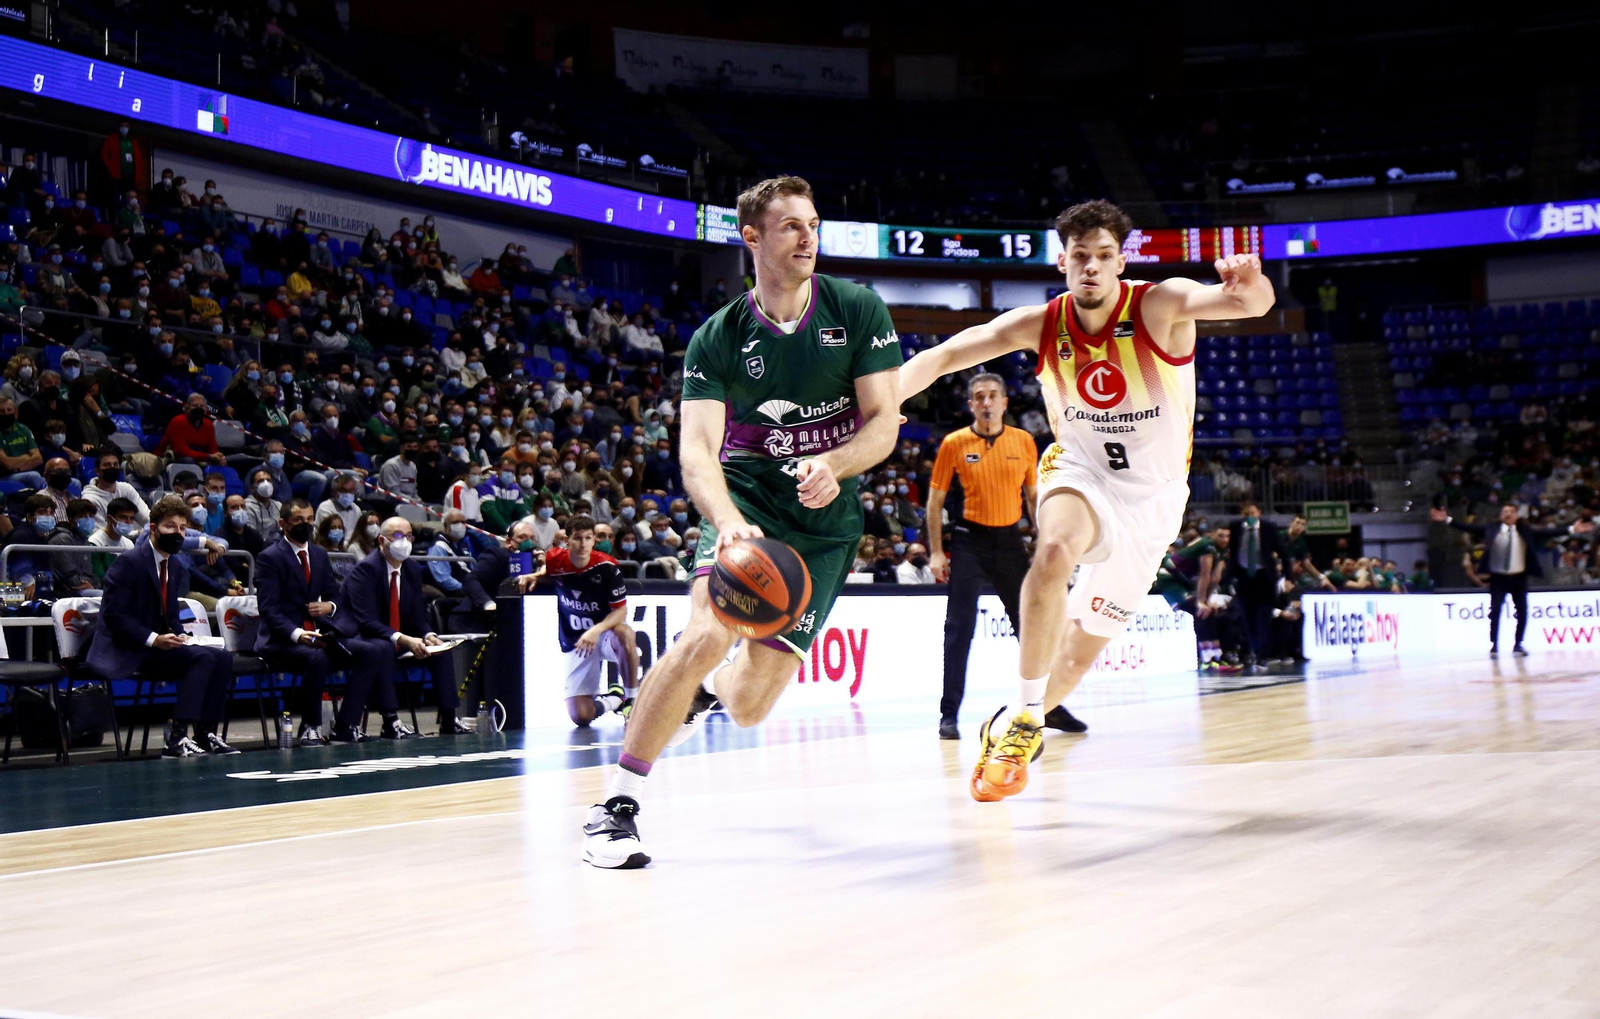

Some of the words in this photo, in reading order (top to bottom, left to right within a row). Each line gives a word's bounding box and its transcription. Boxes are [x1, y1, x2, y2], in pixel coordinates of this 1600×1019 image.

[421, 145, 552, 206] BENAHAVIS
[1540, 202, 1600, 236] BEN
[894, 230, 925, 255] 12
[942, 237, 961, 250] liga
[1000, 234, 1032, 258] 15
[1064, 405, 1161, 424] Casademont
[1092, 424, 1137, 434] ZARAGOZA
[1103, 441, 1130, 471] 9
[560, 593, 601, 617] AMBAR
[1106, 601, 1136, 617] Zarag
[1443, 602, 1492, 620] Tod
[1532, 598, 1600, 619] actual
[569, 618, 595, 636] 00
[1314, 601, 1366, 656] Málaga
[1374, 601, 1399, 651] hoy
[1542, 626, 1600, 645] ww
